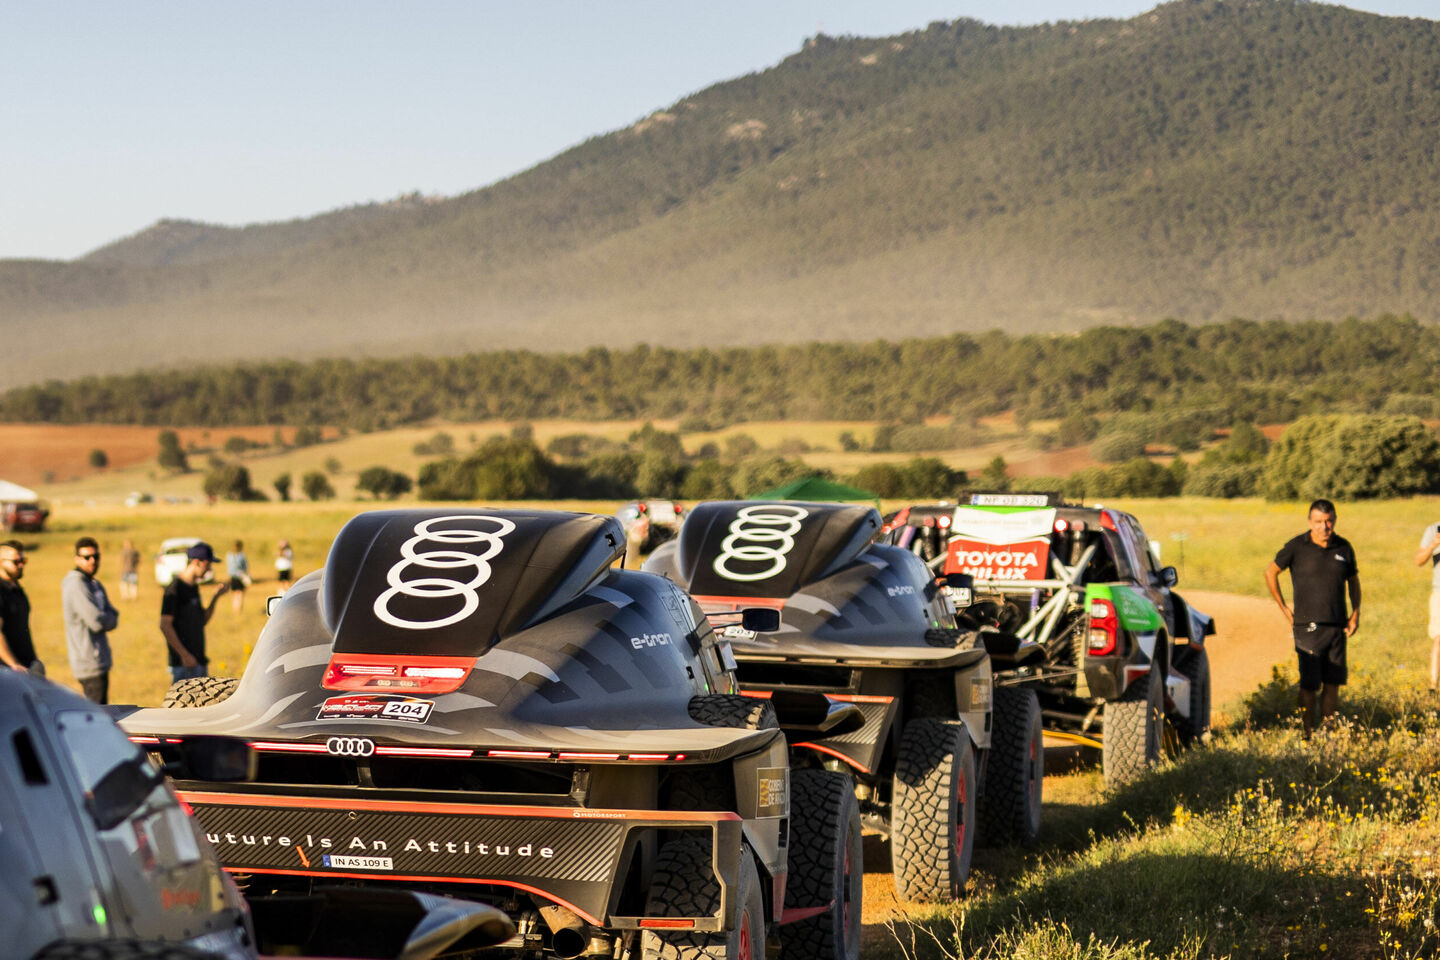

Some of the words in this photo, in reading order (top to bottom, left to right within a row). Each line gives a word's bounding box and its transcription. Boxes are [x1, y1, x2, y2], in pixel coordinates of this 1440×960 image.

[955, 551, 1038, 567] TOYOTA
[631, 633, 673, 649] e-tron
[388, 703, 423, 716] 204
[206, 832, 291, 847] uture
[306, 834, 332, 848] Is
[348, 836, 387, 850] An
[404, 838, 554, 859] Attitude
[335, 857, 345, 866] IN
[348, 858, 360, 867] AS
[363, 859, 381, 867] 109
[383, 860, 389, 868] E
